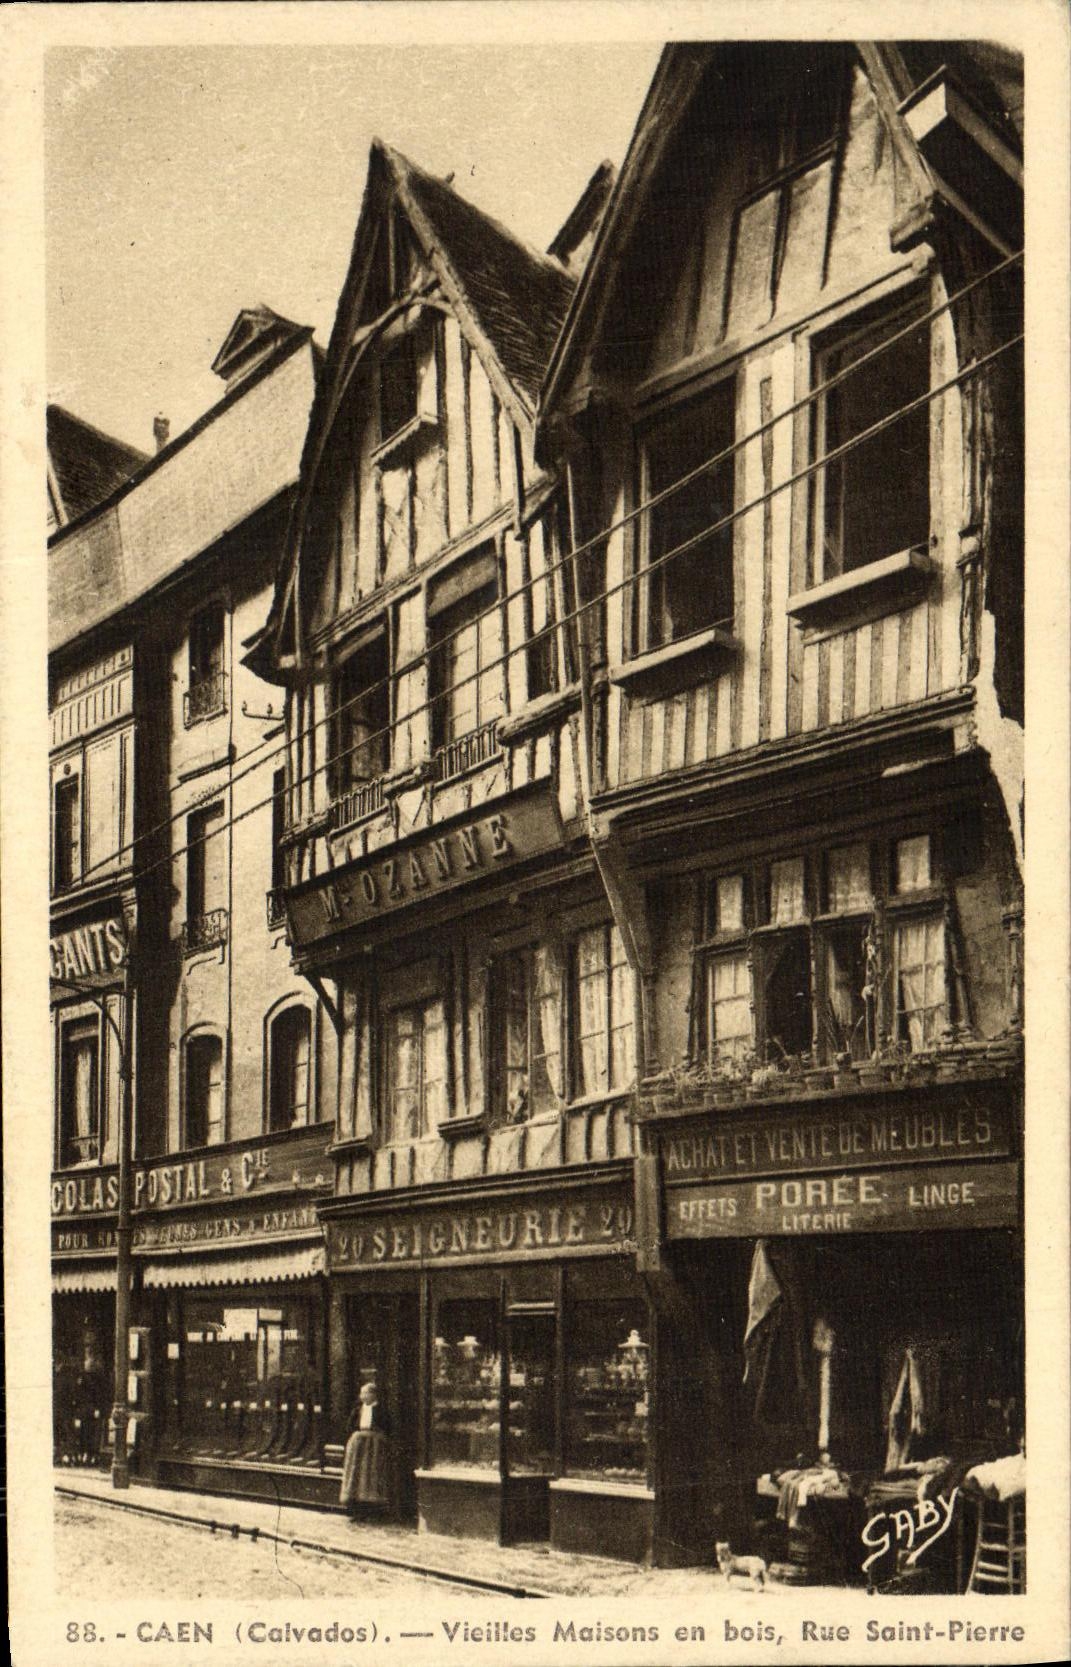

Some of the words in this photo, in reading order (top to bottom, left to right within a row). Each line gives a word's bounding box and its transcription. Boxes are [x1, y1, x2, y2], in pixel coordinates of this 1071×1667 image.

[361, 814, 511, 904] OZANNE
[49, 919, 124, 979] GANTS
[668, 1135, 727, 1171] ACHAT
[734, 1131, 757, 1164] ET
[765, 1123, 833, 1163] VENTE
[839, 1120, 864, 1154] DE
[871, 1107, 992, 1152] MEUBLES
[51, 1175, 119, 1214] COLAS
[135, 1161, 210, 1206] POSTAL
[221, 1168, 233, 1195] &
[679, 1197, 738, 1221] EFFETS
[755, 1174, 884, 1210] PORÉE
[909, 1181, 976, 1207] LINGE
[58, 1232, 89, 1250] POUR
[338, 1234, 363, 1260] 20
[372, 1206, 586, 1260] SEIGNEURIE
[599, 1205, 633, 1237] 20
[782, 1212, 852, 1232] LITERIE
